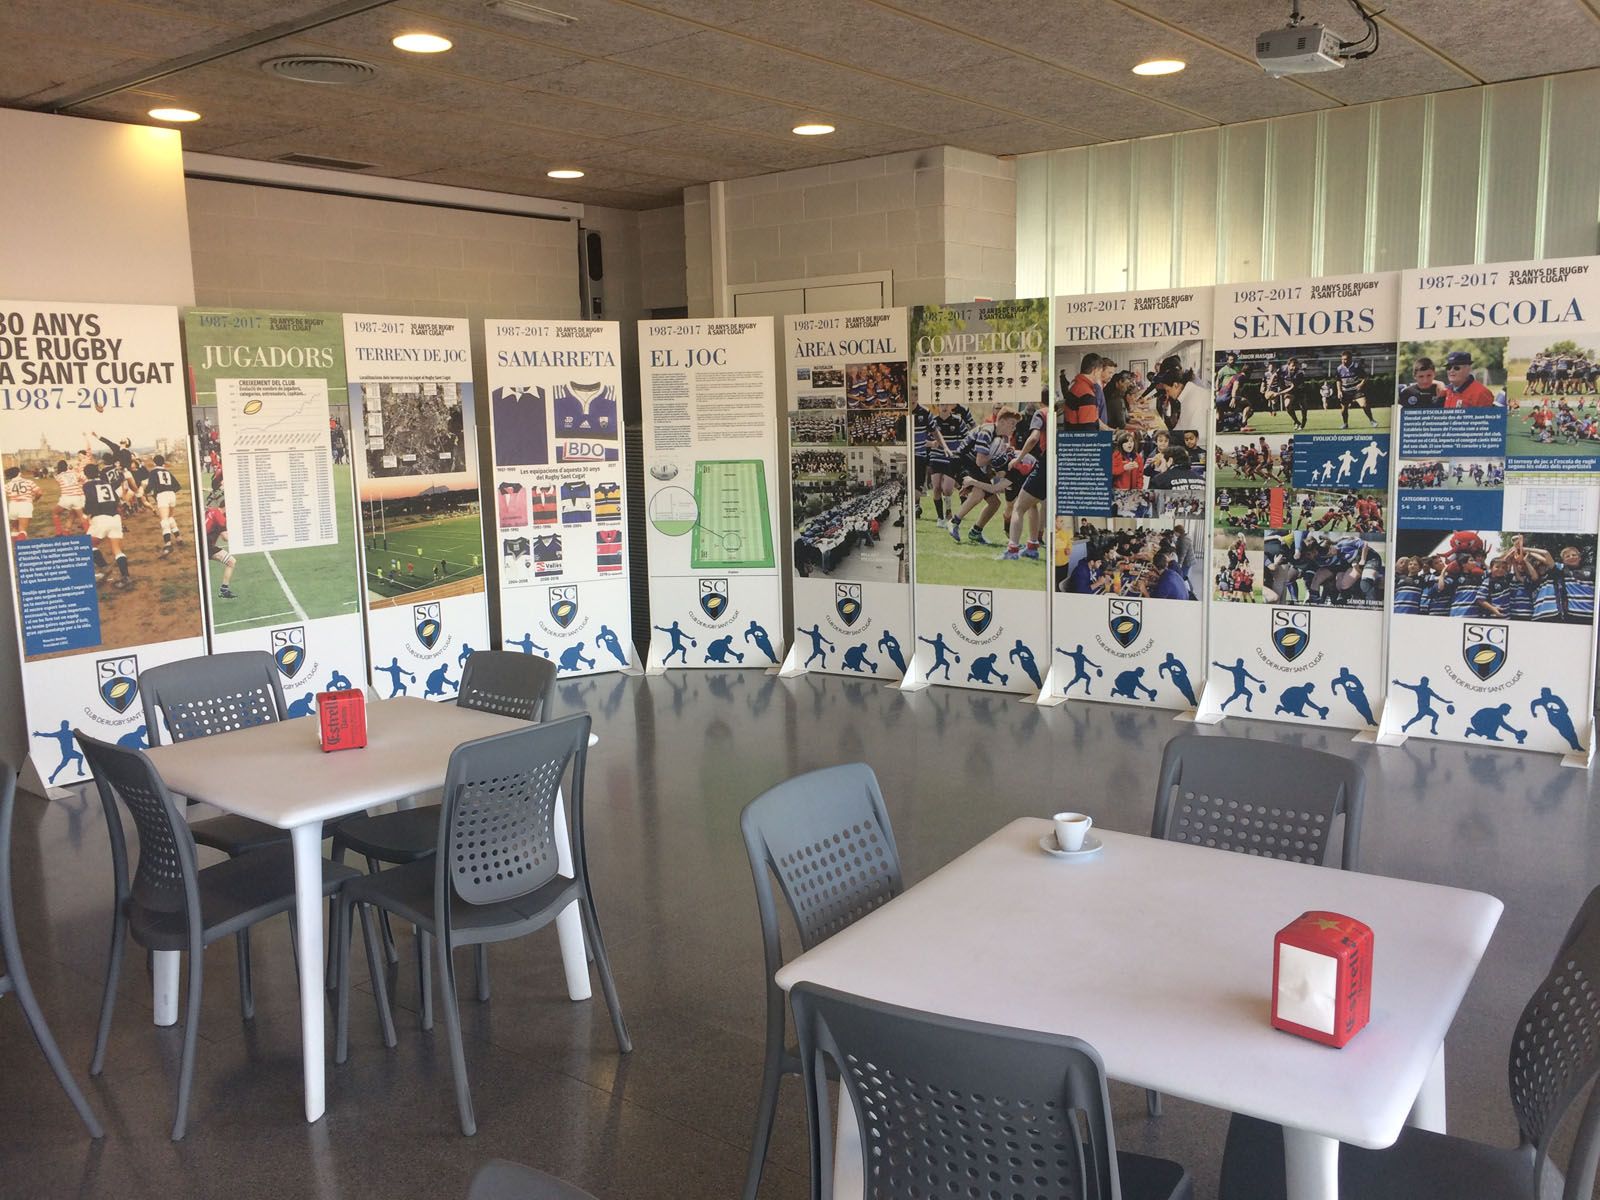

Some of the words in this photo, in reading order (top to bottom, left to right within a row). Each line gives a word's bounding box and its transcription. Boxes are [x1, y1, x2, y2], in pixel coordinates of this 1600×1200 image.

[1508, 277, 1515, 286] A
[1516, 276, 1539, 285] SANT
[1540, 274, 1569, 284] CUGAT
[1509, 270, 1520, 278] 30
[1521, 268, 1545, 277] ANYS
[1546, 267, 1559, 276] DE
[1560, 266, 1589, 275] RUGBY
[1311, 285, 1320, 293] 30
[1321, 284, 1341, 292] ANYS
[1342, 283, 1352, 291] DE
[1353, 281, 1379, 290] RUGBY
[1418, 272, 1499, 290] 1987-2017
[1143, 296, 1160, 304] ANYS
[1171, 294, 1194, 302] RUGBY
[1234, 286, 1302, 304] 1987-2017
[1310, 292, 1316, 300] A
[1316, 291, 1336, 299] SANT
[1337, 289, 1362, 298] CUGAT
[1067, 299, 1127, 314] 1987-2017
[1133, 303, 1139, 311] A
[1139, 303, 1156, 311] SANT
[1157, 301, 1179, 310] CUGAT
[1416, 297, 1585, 330] L'ESCOLA
[199, 315, 263, 329] 1987-2017
[925, 309, 972, 321] 987-2017
[32, 312, 101, 337] ANYS
[354, 321, 405, 334] 1987-2017
[496, 326, 549, 337] 1987-2017
[649, 325, 701, 337] 1987-2017
[738, 322, 757, 330] RUGBY
[793, 318, 840, 331] 1987-2017
[863, 320, 880, 328] CUGAT
[1066, 323, 1135, 342] TERCER
[1138, 319, 1200, 338] TEMPS
[1233, 307, 1375, 340] SÈNIORS
[918, 322, 1043, 355] COMPETICIÓ
[0, 337, 29, 360] DE
[36, 337, 122, 361] RUGBY
[355, 347, 421, 362] TERRENY
[423, 348, 442, 362] DE
[443, 349, 467, 363] JOC
[795, 337, 836, 358] ÀREA
[839, 338, 897, 356] SOCIAL
[202, 345, 334, 370] JUGADORS
[498, 350, 616, 368] SAMARRETA
[650, 349, 679, 368] EL
[684, 347, 727, 369] JOC
[0, 362, 16, 385] A
[21, 361, 88, 385] SANT
[95, 362, 175, 385] CUGAT
[1, 387, 137, 411] 1987-2017
[569, 442, 604, 457] BDO
[11, 481, 28, 495] 45
[101, 486, 112, 500] 3
[551, 587, 576, 601] SC
[701, 580, 726, 593] SC
[837, 584, 860, 598] SC
[965, 591, 990, 606] SC
[416, 604, 439, 621] SC
[1111, 600, 1139, 617] SC
[1275, 611, 1307, 628] SC
[275, 629, 302, 647] SC
[1466, 625, 1505, 644] SC
[1256, 647, 1267, 662] CLUB
[1265, 660, 1275, 668] DE
[1273, 663, 1293, 673] RUGBY
[1293, 664, 1308, 673] SANT
[1308, 651, 1325, 668] CUGAT
[101, 658, 135, 679] SC
[1444, 664, 1457, 681] CLUB
[1456, 678, 1465, 687] DE
[1464, 682, 1487, 693] RUGBY
[1487, 684, 1505, 693] SANT
[1505, 669, 1524, 688] CUGAT
[84, 706, 97, 720] CLUB
[96, 717, 105, 725] DE
[105, 719, 125, 727] RUGBY
[126, 712, 142, 724] SANT
